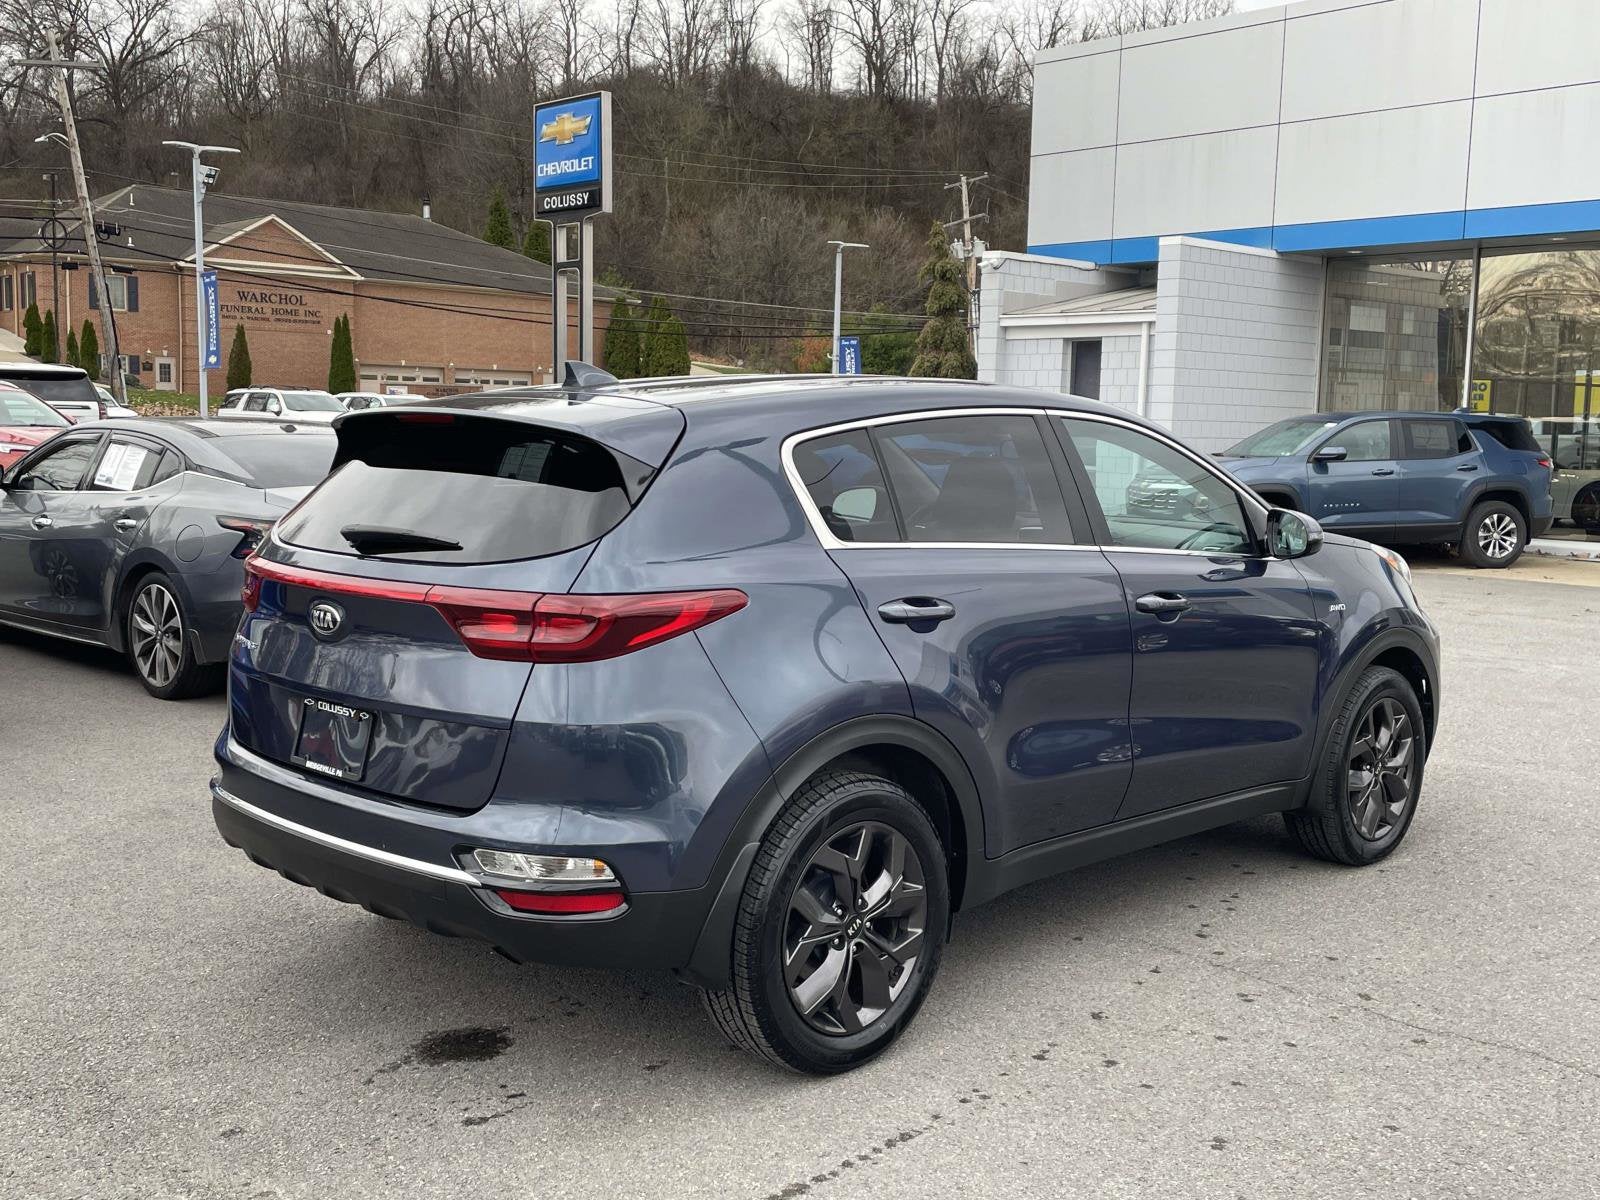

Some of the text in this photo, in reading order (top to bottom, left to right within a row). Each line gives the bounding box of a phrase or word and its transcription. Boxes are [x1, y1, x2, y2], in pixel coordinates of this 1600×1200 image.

[537, 156, 594, 177] CHEVROLET
[543, 192, 589, 210] COLUSSY
[237, 290, 307, 306] WARCHOL
[220, 304, 266, 315] FUNERAL
[271, 307, 300, 317] HOME
[1329, 603, 1346, 612] AWD
[313, 609, 334, 629] KIA
[317, 701, 356, 718] COLUSSY
[847, 918, 862, 936] KIA
